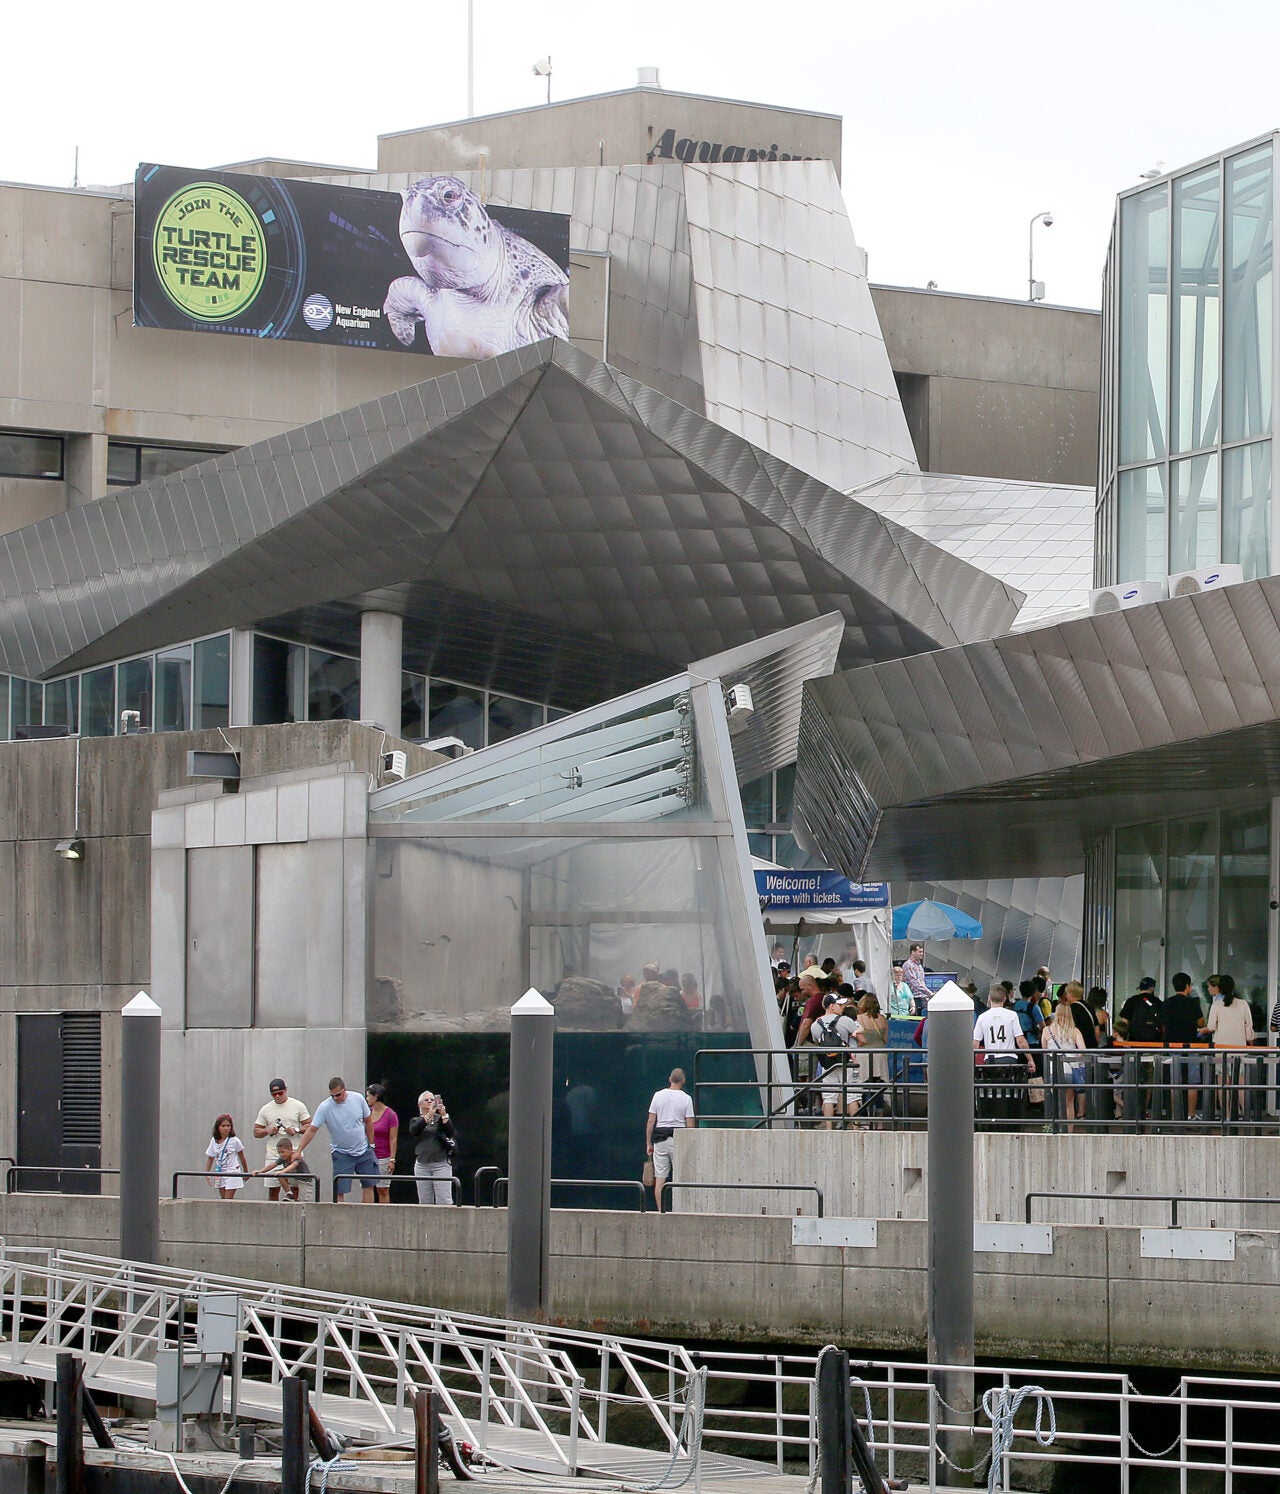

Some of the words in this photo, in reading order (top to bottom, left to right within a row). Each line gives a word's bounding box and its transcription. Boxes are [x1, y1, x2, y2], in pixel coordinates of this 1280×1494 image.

[178, 199, 211, 221] JOIN
[218, 202, 243, 228] THE
[162, 226, 256, 254] TURTLE
[162, 246, 256, 273] RESCUE
[176, 268, 240, 291] TEAM
[335, 304, 351, 315] New
[353, 306, 381, 319] England
[336, 316, 370, 329] Aquarium
[766, 875, 821, 890] Welcome!
[771, 893, 790, 904] here
[792, 892, 810, 903] with
[813, 892, 843, 903] tickets.
[989, 1024, 1007, 1044] 14
